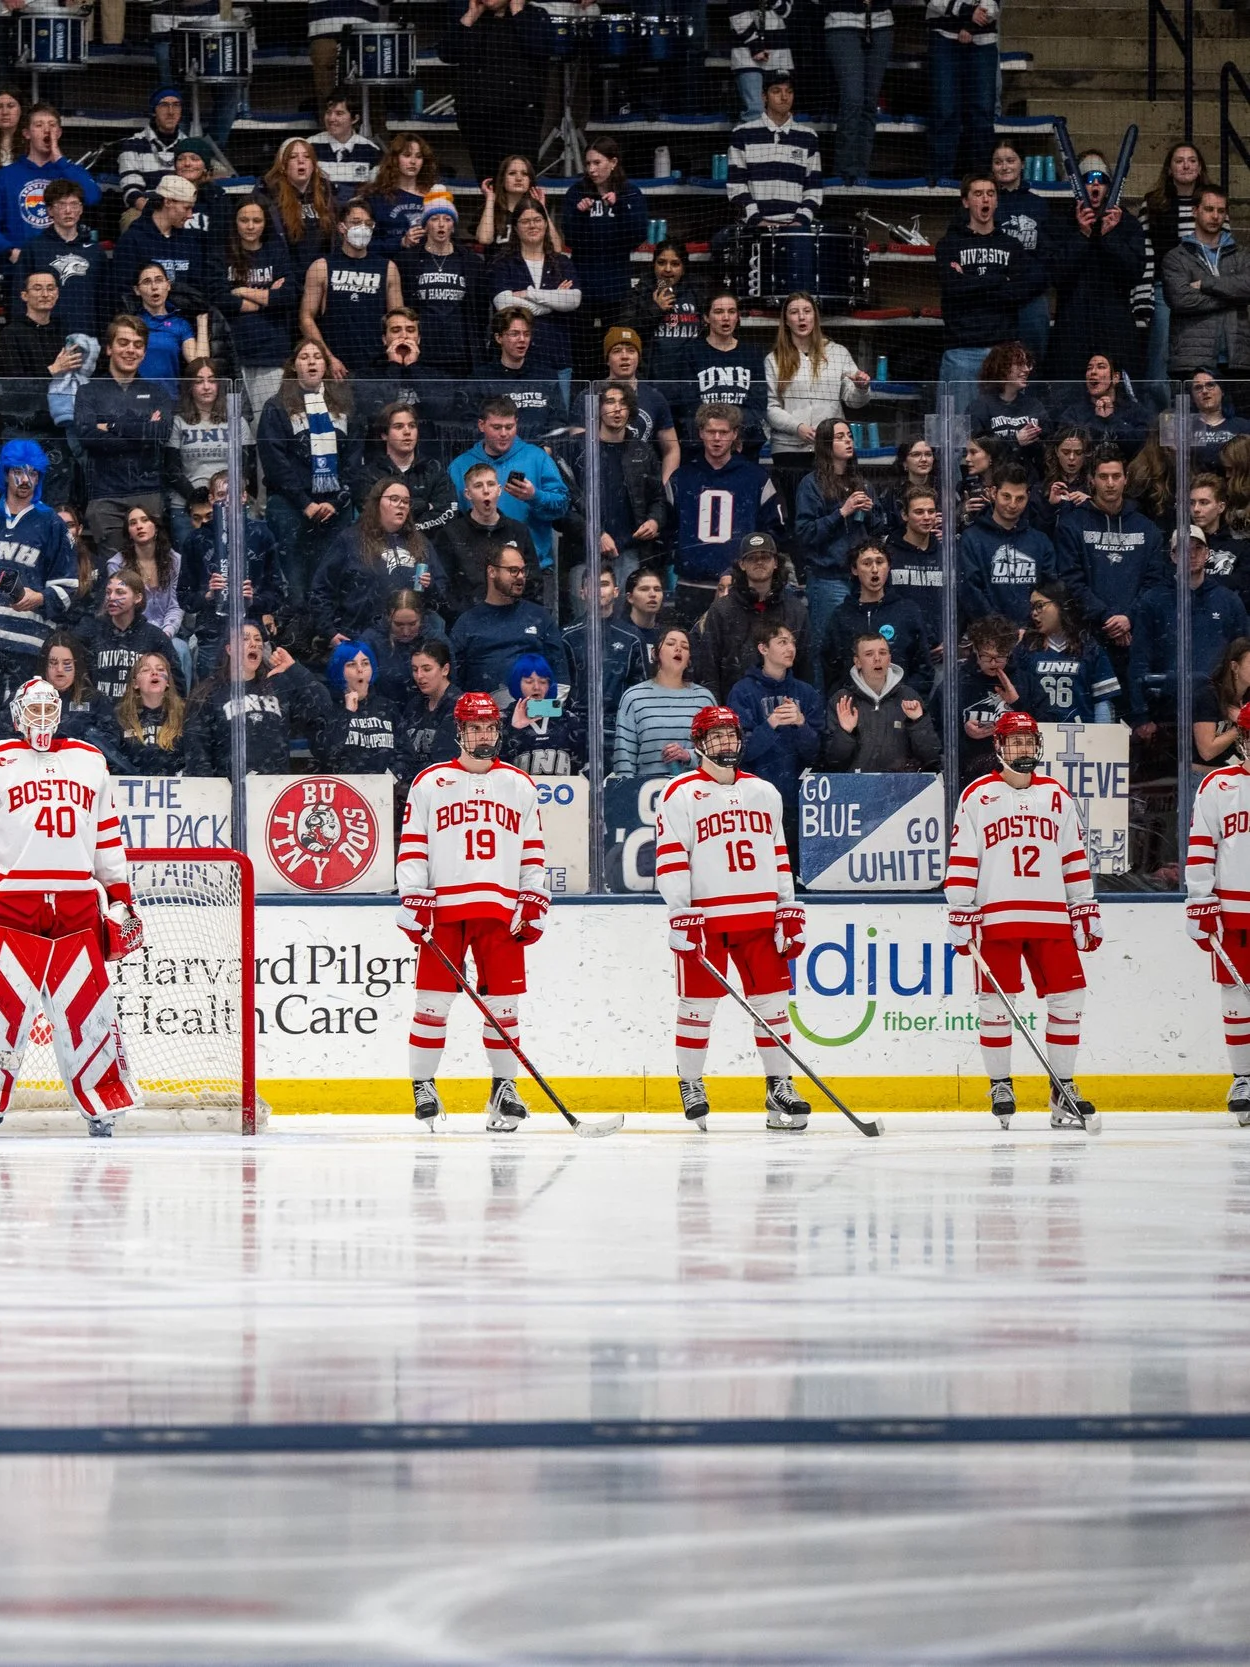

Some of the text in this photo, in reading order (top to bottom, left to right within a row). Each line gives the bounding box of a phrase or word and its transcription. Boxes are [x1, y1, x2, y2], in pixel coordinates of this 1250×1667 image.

[55, 32, 65, 59] YAMAHA
[222, 45, 233, 72] YAMAHA
[382, 47, 393, 74] YAMAHA
[959, 247, 1010, 267] NIVERSITY
[330, 270, 381, 288] UNH
[332, 283, 379, 294] WILDCATS
[653, 324, 699, 338] SEBALL
[697, 366, 751, 392] UNH
[184, 428, 229, 446] UN
[1094, 543, 1134, 551] WILDCATS
[97, 649, 144, 668] UNIVERSI
[1036, 660, 1080, 674] UNH
[118, 669, 128, 681] OF
[97, 681, 111, 697] NEW
[36, 733, 50, 746] 40
[113, 779, 177, 808] THE
[302, 783, 337, 804] BU
[803, 775, 832, 802] GO
[1037, 761, 1129, 799] IEVE
[8, 779, 96, 813] BOSTON
[1050, 791, 1063, 815] A
[34, 806, 76, 838] 40
[436, 799, 522, 835] BOSTON
[696, 809, 773, 844] BOSTON
[802, 803, 862, 838] BLUE
[906, 816, 940, 845] GO
[115, 814, 227, 849] AT PACK
[337, 807, 370, 871] DOGS
[464, 828, 496, 861] 19
[273, 811, 331, 885] TINY
[725, 840, 757, 873] 16
[1012, 845, 1041, 878] 12
[847, 848, 942, 883] WHITE
[403, 897, 436, 908] BAUE
[519, 893, 549, 910] BAUE
[775, 906, 806, 919] BAUE
[1070, 905, 1099, 917] BAU
[672, 916, 705, 929] BAUE
[113, 940, 440, 999] Harvrd Pilgri
[275, 994, 379, 1035] Care
[882, 1011, 1037, 1032] fiber inteet
[110, 1017, 128, 1072] TRUE
